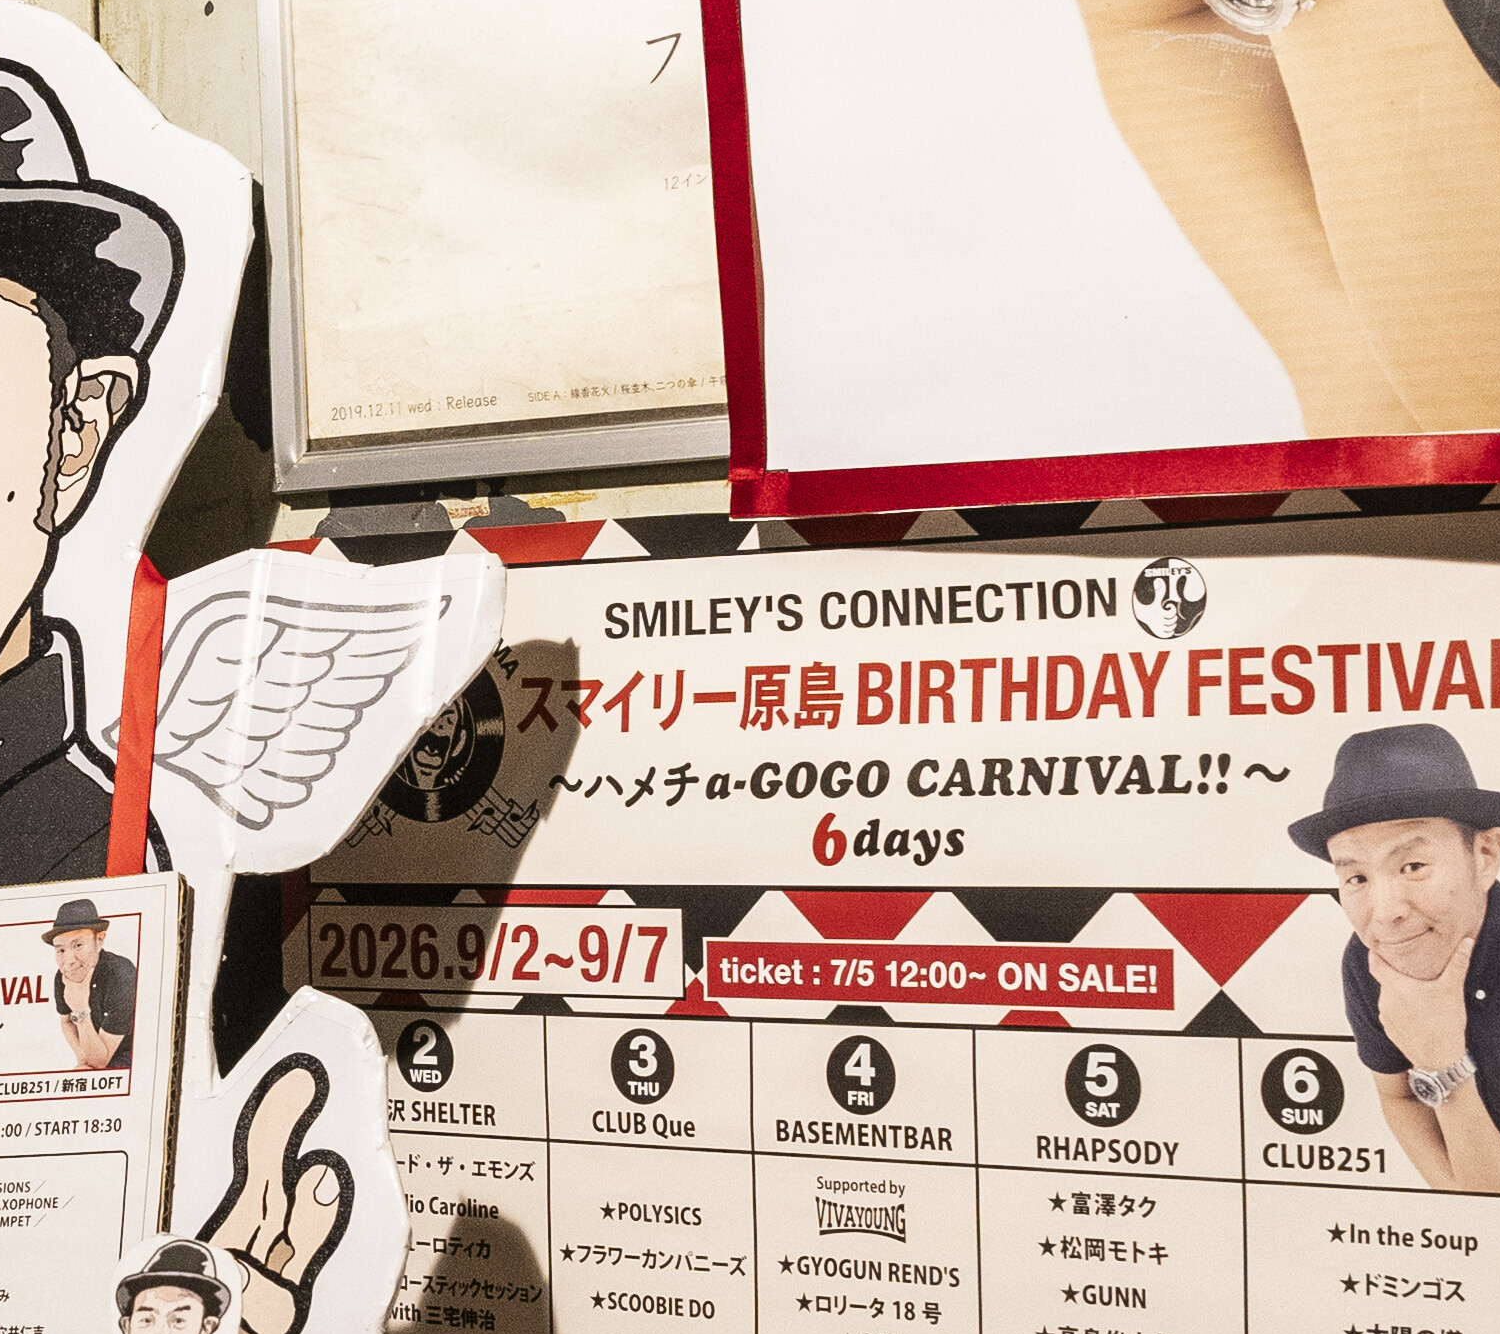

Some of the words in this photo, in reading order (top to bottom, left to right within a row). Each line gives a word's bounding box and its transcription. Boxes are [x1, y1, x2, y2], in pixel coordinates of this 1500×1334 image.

[408, 399, 433, 414] wed
[446, 393, 498, 411] Release
[602, 591, 804, 641] SMILEY'S
[820, 577, 1118, 631] CONNECTION
[515, 660, 843, 734] スマイリー原島
[856, 649, 1172, 727] BIRTHDAY
[719, 956, 803, 986] ticket
[830, 957, 875, 987] 7/5
[997, 960, 1049, 991] ON
[1058, 962, 1159, 994] SALE!
[410, 1069, 442, 1084] WED
[627, 1081, 660, 1096] THU
[847, 1091, 874, 1107] FRI
[1085, 1101, 1121, 1119] SAT
[412, 1102, 496, 1127] SHELTER
[592, 1110, 646, 1134] CLUB
[652, 1114, 696, 1140] Que
[1280, 1107, 1324, 1126] SUN
[34, 1120, 78, 1137] START
[83, 1118, 122, 1135] 18:30
[775, 1119, 953, 1152] BASEMENTBAR
[1036, 1135, 1179, 1167] RHAPSODY
[1262, 1142, 1388, 1175] CLUB251
[816, 1176, 886, 1195] Supported
[429, 1196, 500, 1220] Caroline
[618, 1202, 702, 1226] POLYSICS
[1377, 1225, 1413, 1248] the
[1420, 1229, 1480, 1257] Soup
[797, 1256, 882, 1282] GYOGUN
[888, 1262, 960, 1288] REND'S
[607, 1291, 684, 1316] SCOOBIE
[689, 1298, 715, 1320] DO
[1082, 1284, 1147, 1309] GUNN
